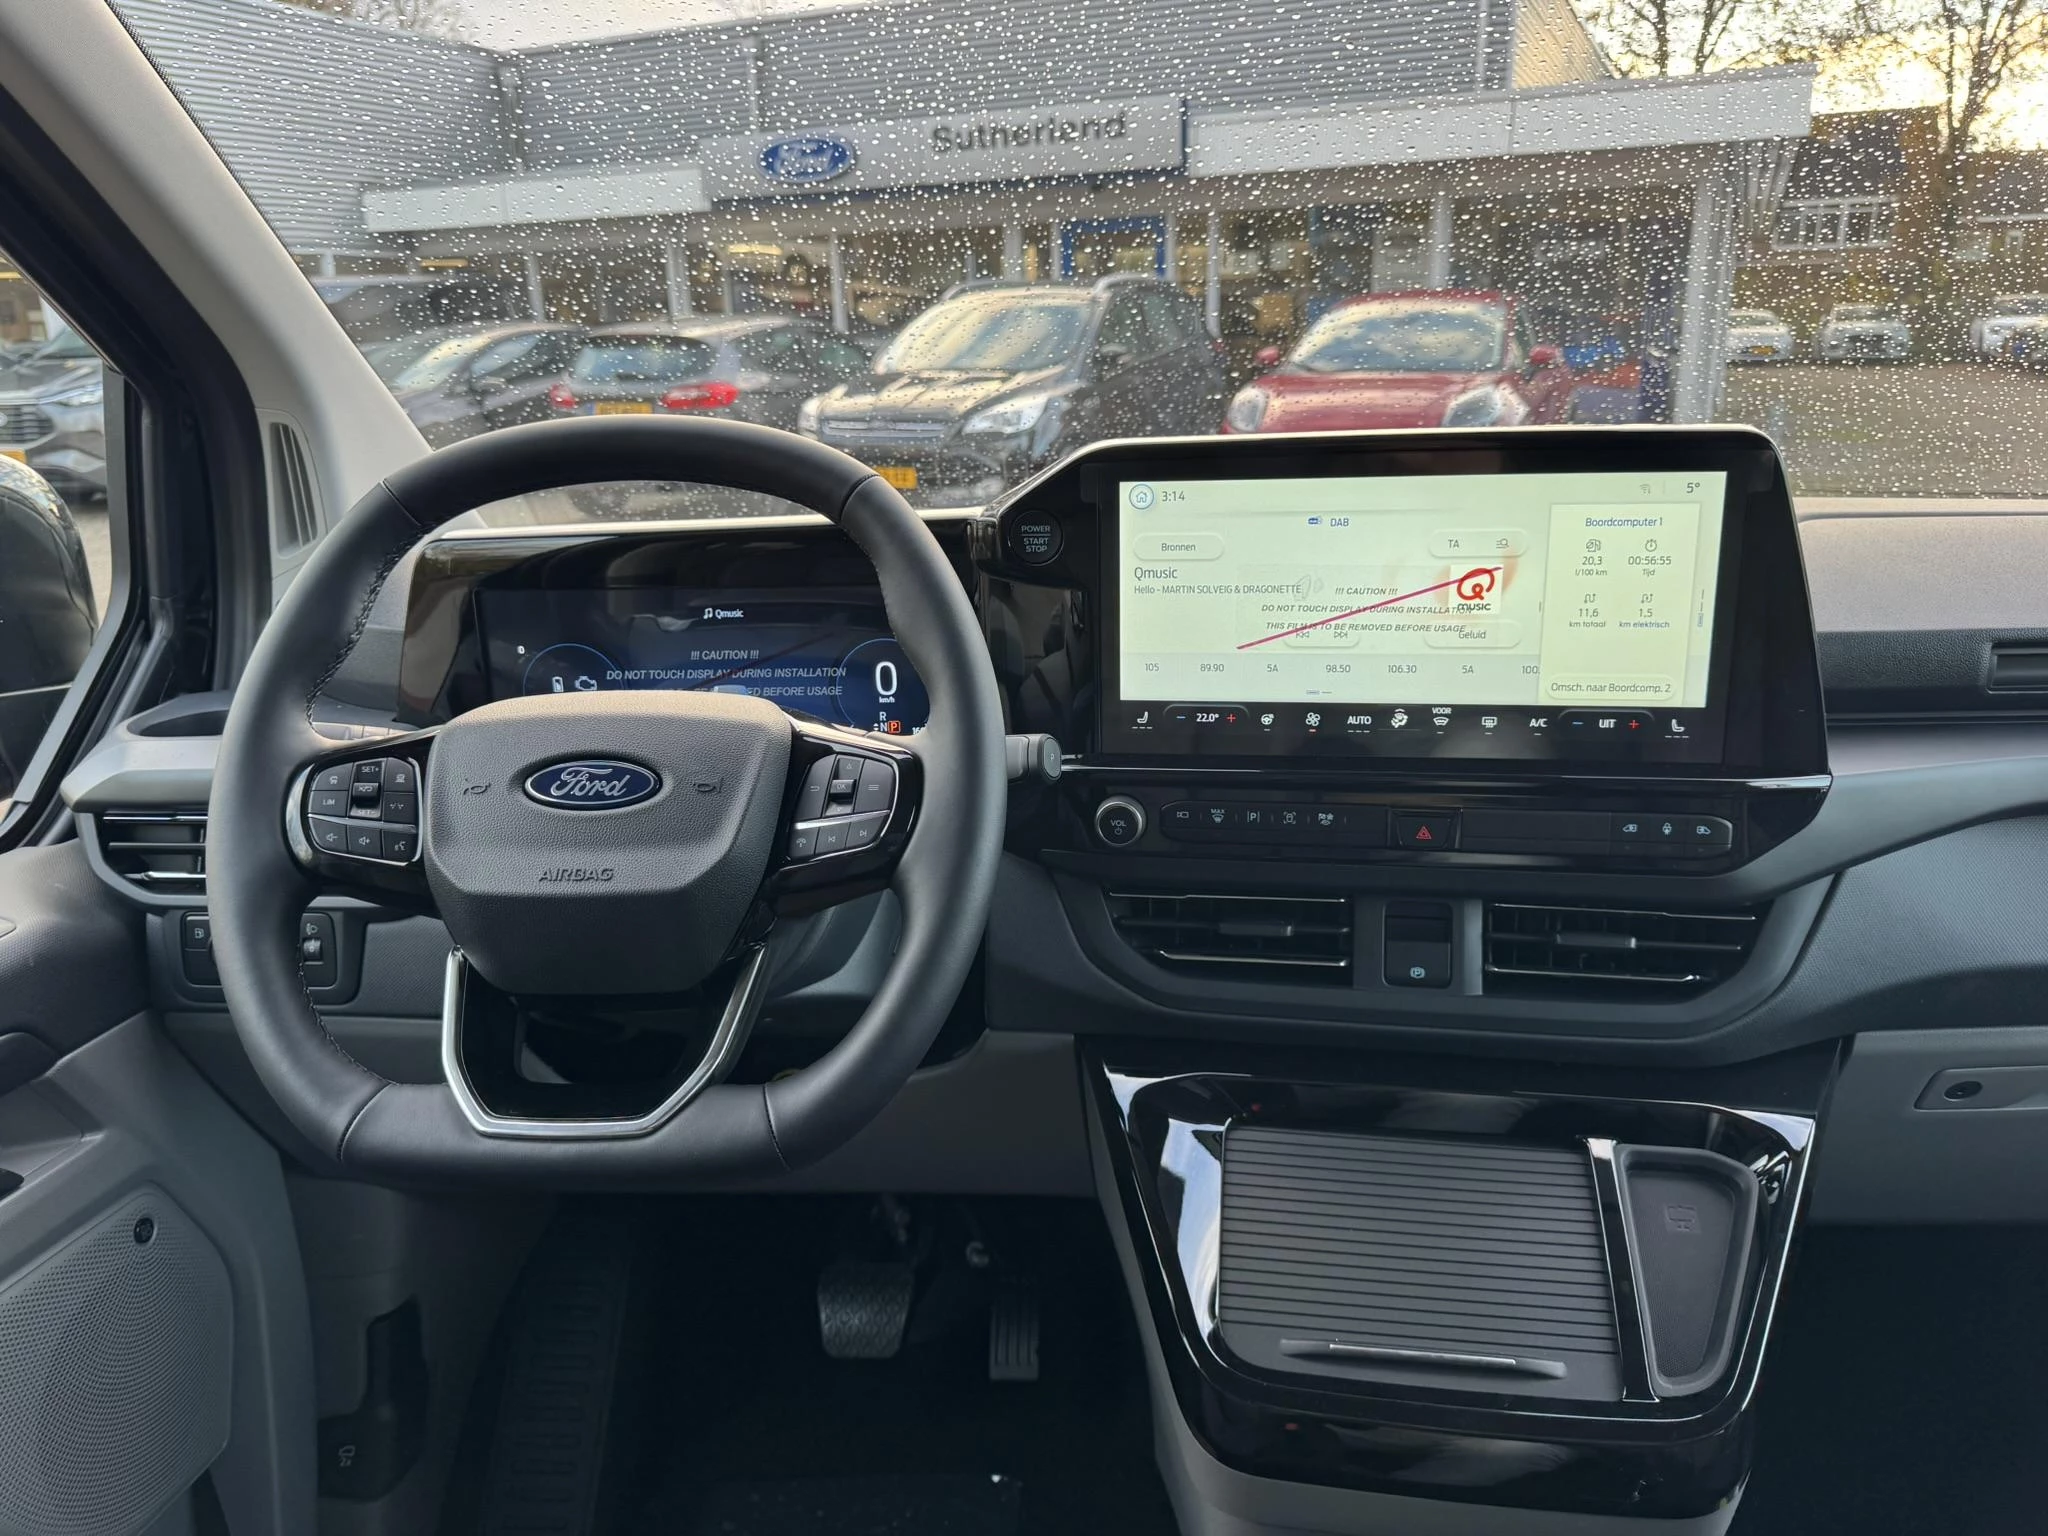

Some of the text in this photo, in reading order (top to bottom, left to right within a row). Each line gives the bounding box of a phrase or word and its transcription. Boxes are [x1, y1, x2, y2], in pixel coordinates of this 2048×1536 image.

[931, 112, 1127, 153] Sutherland
[1161, 491, 1185, 502] 3:14
[1330, 518, 1349, 527] DAB
[1585, 517, 1657, 528] Boordcomputer
[1021, 525, 1051, 533] POWER
[1023, 537, 1049, 545] START
[1448, 539, 1459, 549] TA
[1025, 545, 1048, 553] STOP
[1161, 543, 1196, 552] Bronnen
[1628, 556, 1671, 566] 00:56:55
[1134, 566, 1178, 580] Qmusic
[1642, 569, 1655, 577] Tijd
[1134, 585, 1155, 593] Hello
[1162, 584, 1195, 593] MARTIN
[1197, 585, 1232, 593] SOLVEIG
[1234, 585, 1240, 593] &
[1243, 585, 1301, 593] DRAGONETTE
[715, 609, 744, 619] Qmusic
[1266, 622, 1285, 630] THIS
[1348, 624, 1393, 632] REMOVED
[1394, 624, 1432, 632] BEFORE
[1434, 625, 1466, 633] USAGE
[1582, 620, 1606, 628] totaal
[1458, 631, 1487, 640] Geluid
[702, 651, 748, 659] CAUTION
[606, 671, 622, 679] DO
[624, 670, 645, 679] NOT
[650, 670, 685, 679] TOUCH
[732, 669, 772, 678] DURING
[774, 667, 847, 677] INSTALLATION
[1145, 663, 1160, 672] 105
[1200, 664, 1225, 673] 89.90
[1326, 664, 1351, 674] 98.50
[1387, 664, 1417, 674] 106.30
[875, 661, 898, 696] 0
[763, 687, 805, 696] BEFORE
[807, 686, 843, 695] USAGE
[1551, 682, 1671, 693] Omsch. naar Boordcomp. 2
[880, 712, 887, 721] R
[1347, 716, 1372, 724] AUTO
[880, 722, 898, 732] N P
[1529, 719, 1548, 727] A/C
[1599, 719, 1616, 729] UIT
[550, 767, 630, 796] Ford
[1111, 819, 1126, 827] VOL
[538, 869, 614, 882] AIRBAG
